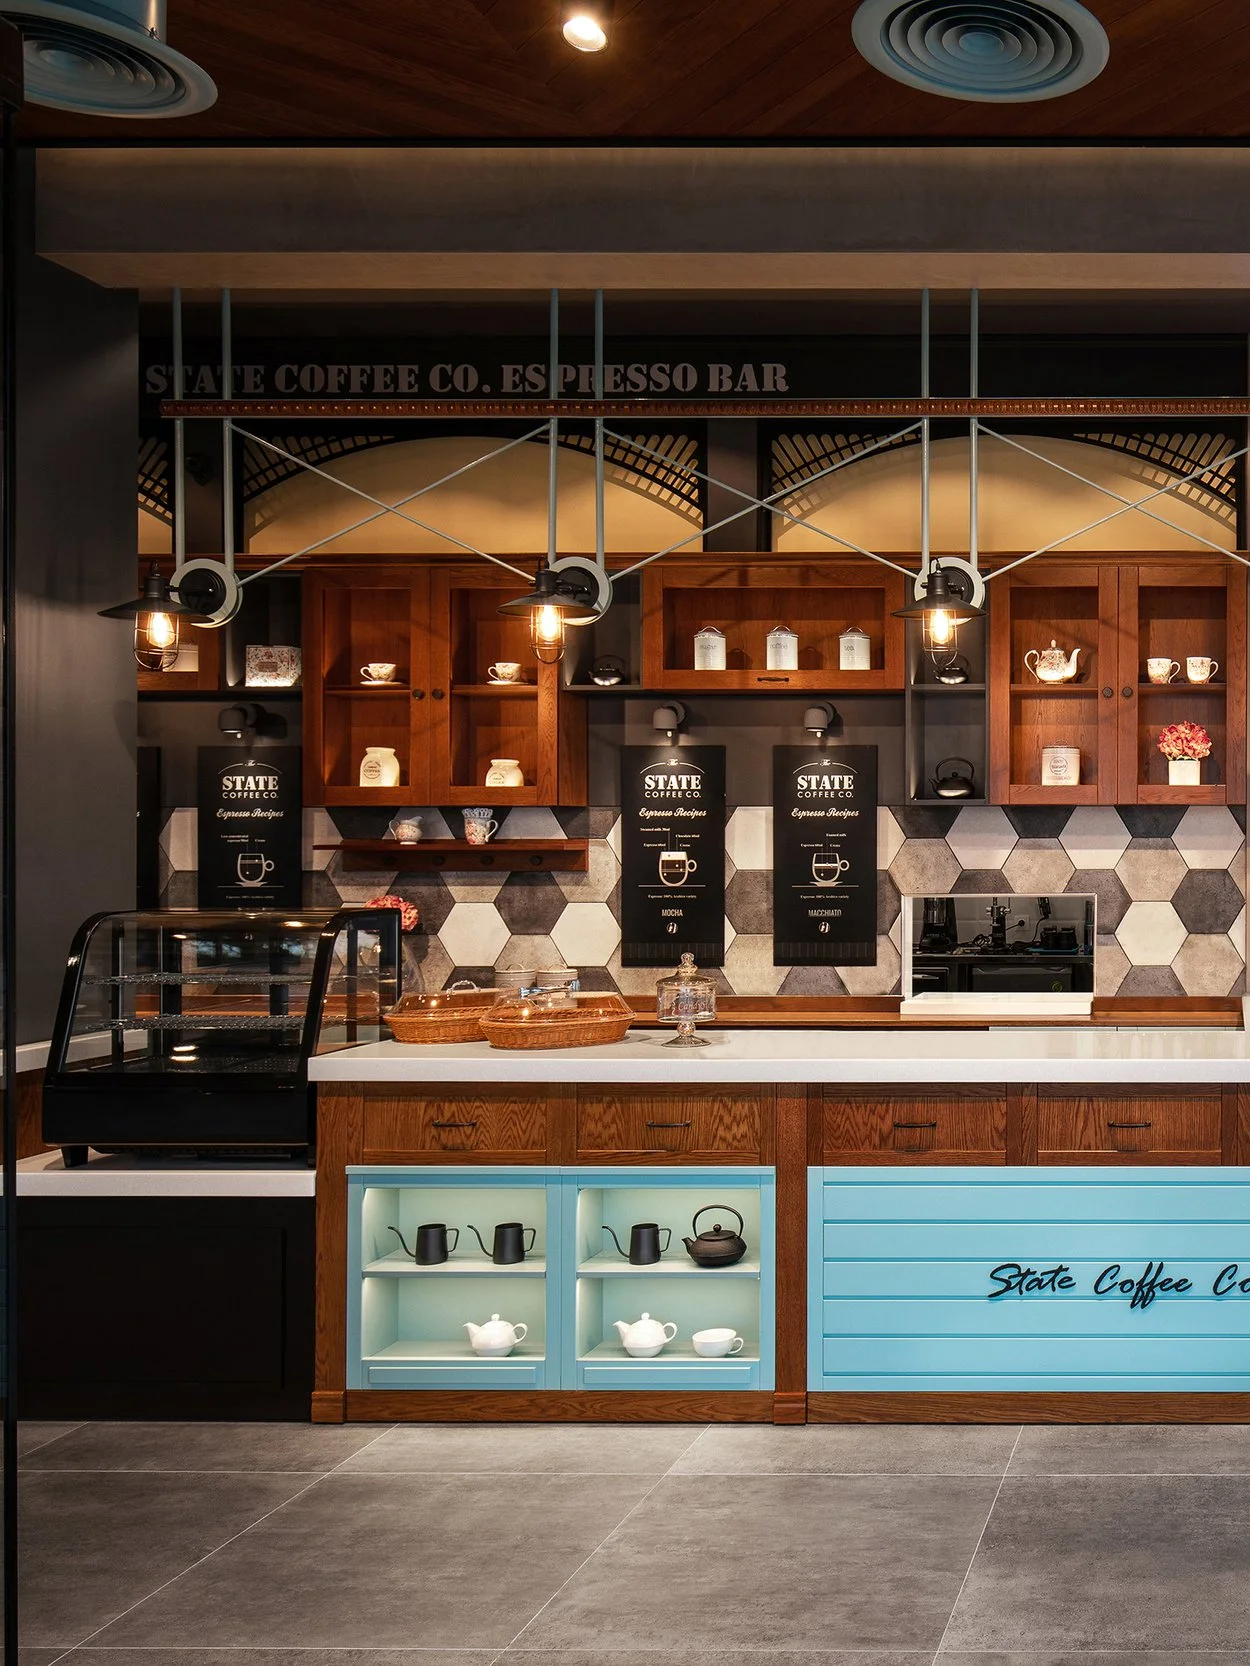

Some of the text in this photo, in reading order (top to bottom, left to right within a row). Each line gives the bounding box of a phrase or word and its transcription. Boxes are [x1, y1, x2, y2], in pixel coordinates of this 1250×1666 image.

[274, 363, 419, 393] COFFEE
[429, 363, 491, 393] CO.
[501, 363, 698, 393] ESPRESSO
[707, 363, 789, 392] BAR
[222, 775, 279, 791] STATE
[644, 775, 701, 790] STATE
[797, 775, 854, 790] STATE
[222, 791, 279, 799] COFFEE CO.
[644, 790, 701, 798] COFFEE CO.
[797, 790, 854, 799] COFFEE CO.
[216, 808, 284, 821] Espresso Recipes
[639, 807, 707, 820] Espresso Recipes
[791, 807, 860, 820] Espresso Recipes
[661, 909, 684, 917] MOCHA
[808, 909, 842, 917] MACCHIATO
[987, 1263, 1076, 1298] State
[1093, 1261, 1193, 1309] Coffee
